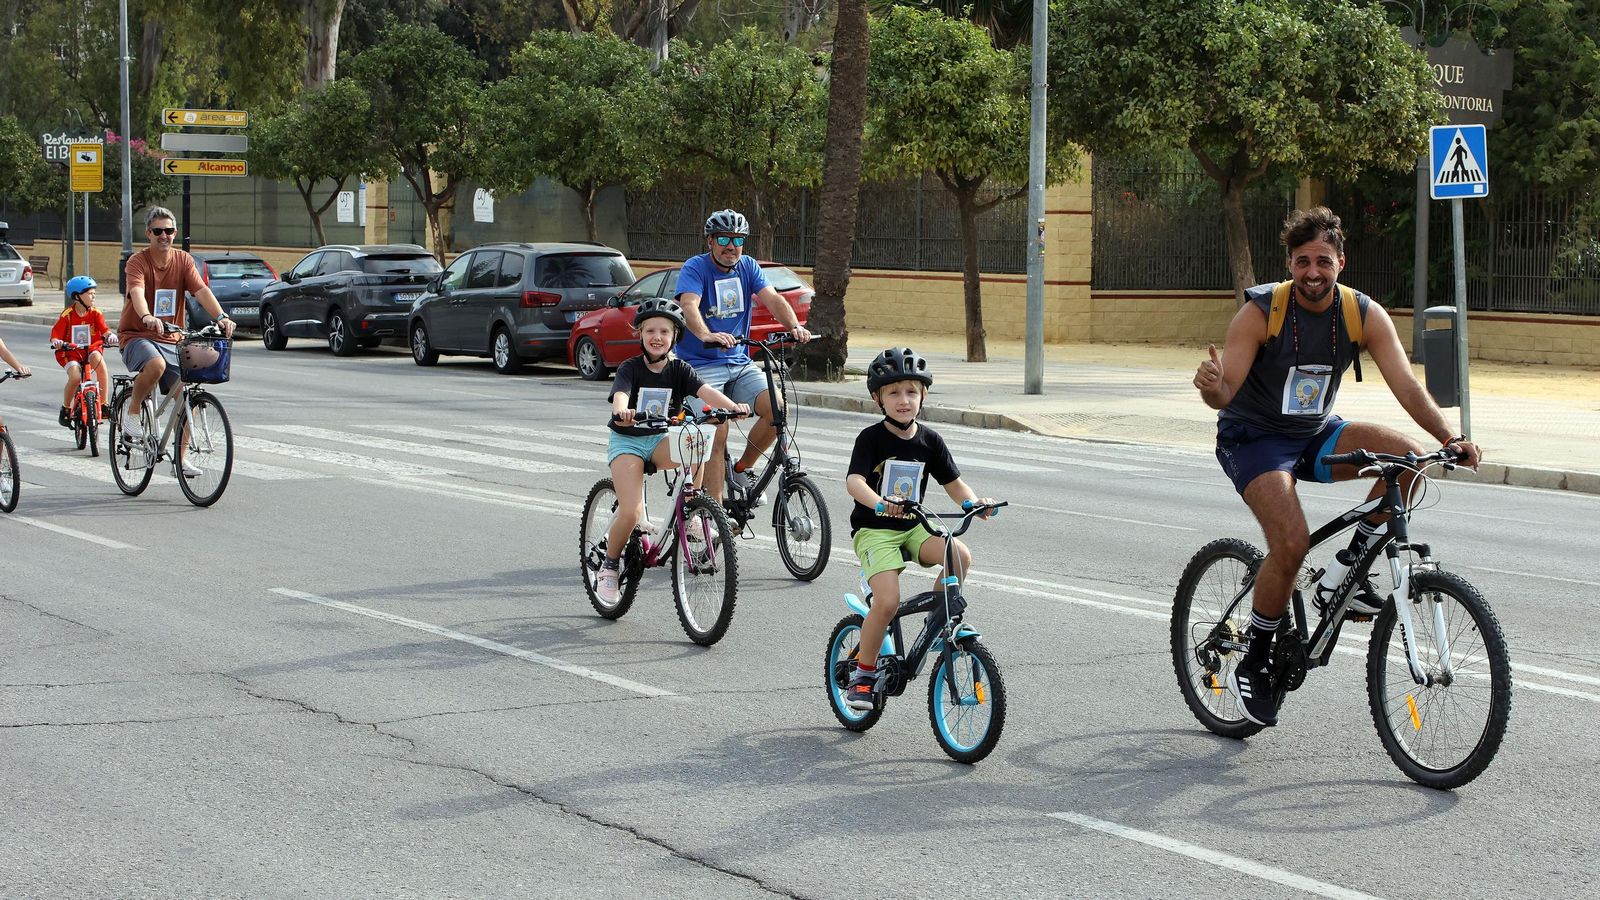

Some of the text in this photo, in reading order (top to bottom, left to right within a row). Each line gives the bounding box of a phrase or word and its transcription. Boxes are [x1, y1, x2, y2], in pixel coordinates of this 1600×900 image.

[200, 114, 245, 122] areasur
[46, 146, 57, 159] El
[198, 162, 244, 172] Alcampo
